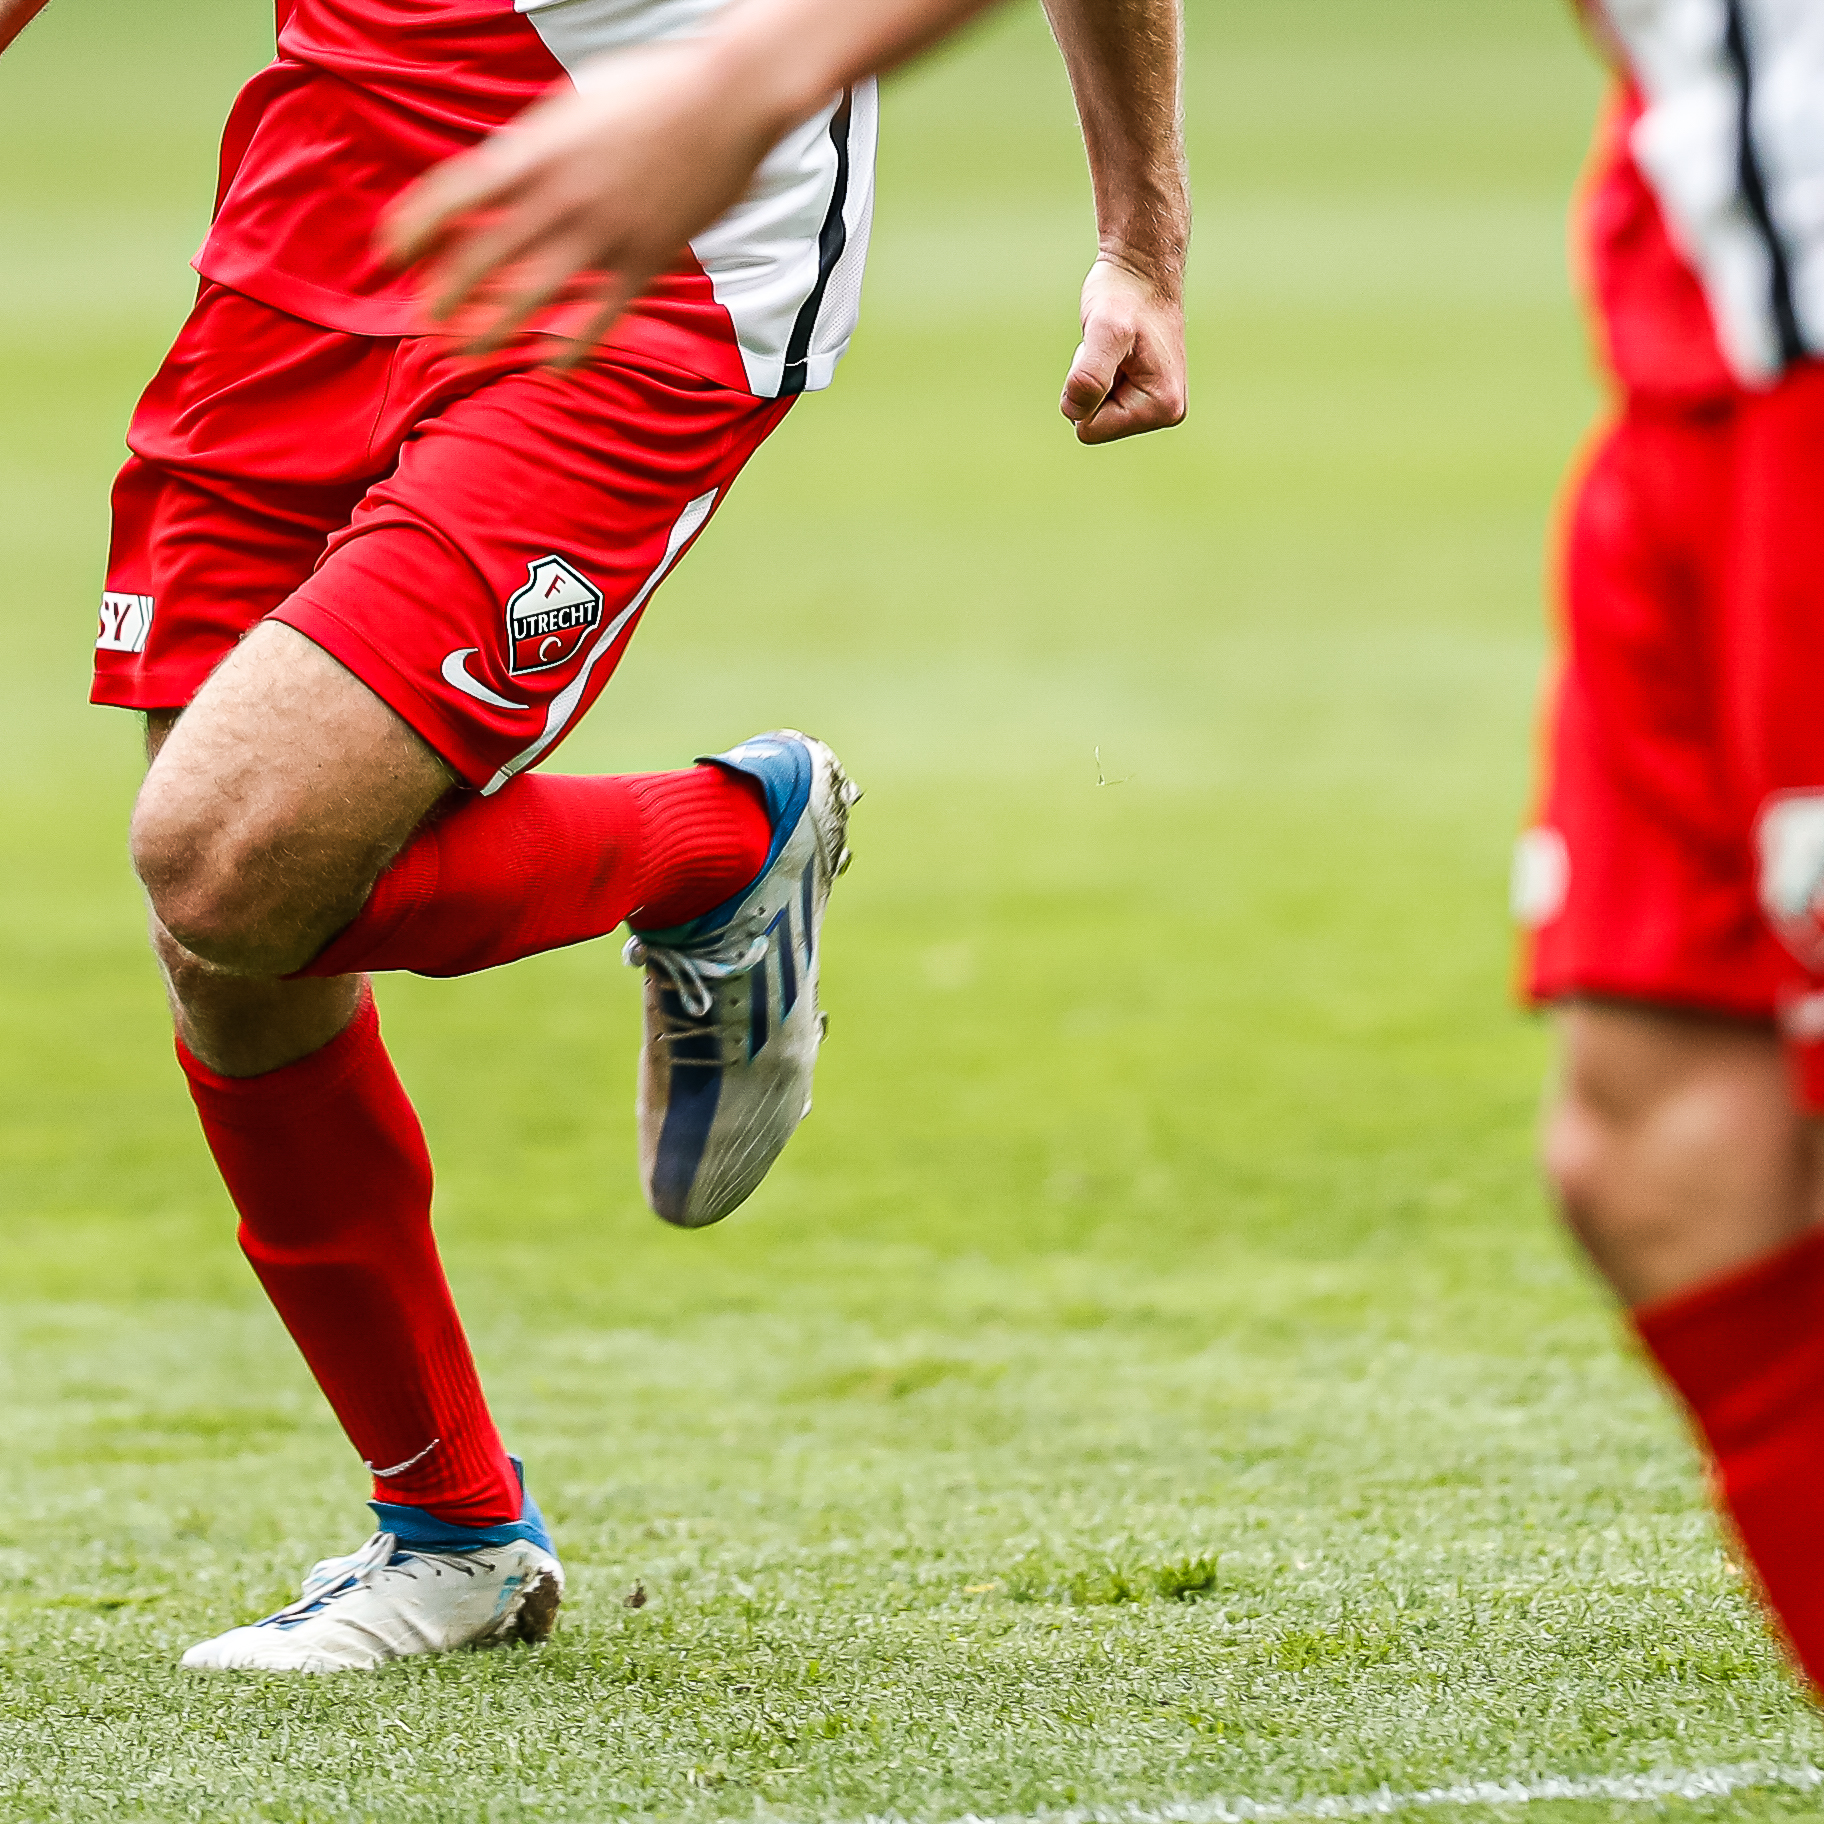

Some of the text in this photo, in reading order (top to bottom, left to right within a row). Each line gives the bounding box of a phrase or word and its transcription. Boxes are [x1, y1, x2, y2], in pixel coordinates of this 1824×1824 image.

[544, 573, 566, 599] F
[513, 601, 596, 639] UTRECHT
[539, 636, 562, 662] C
